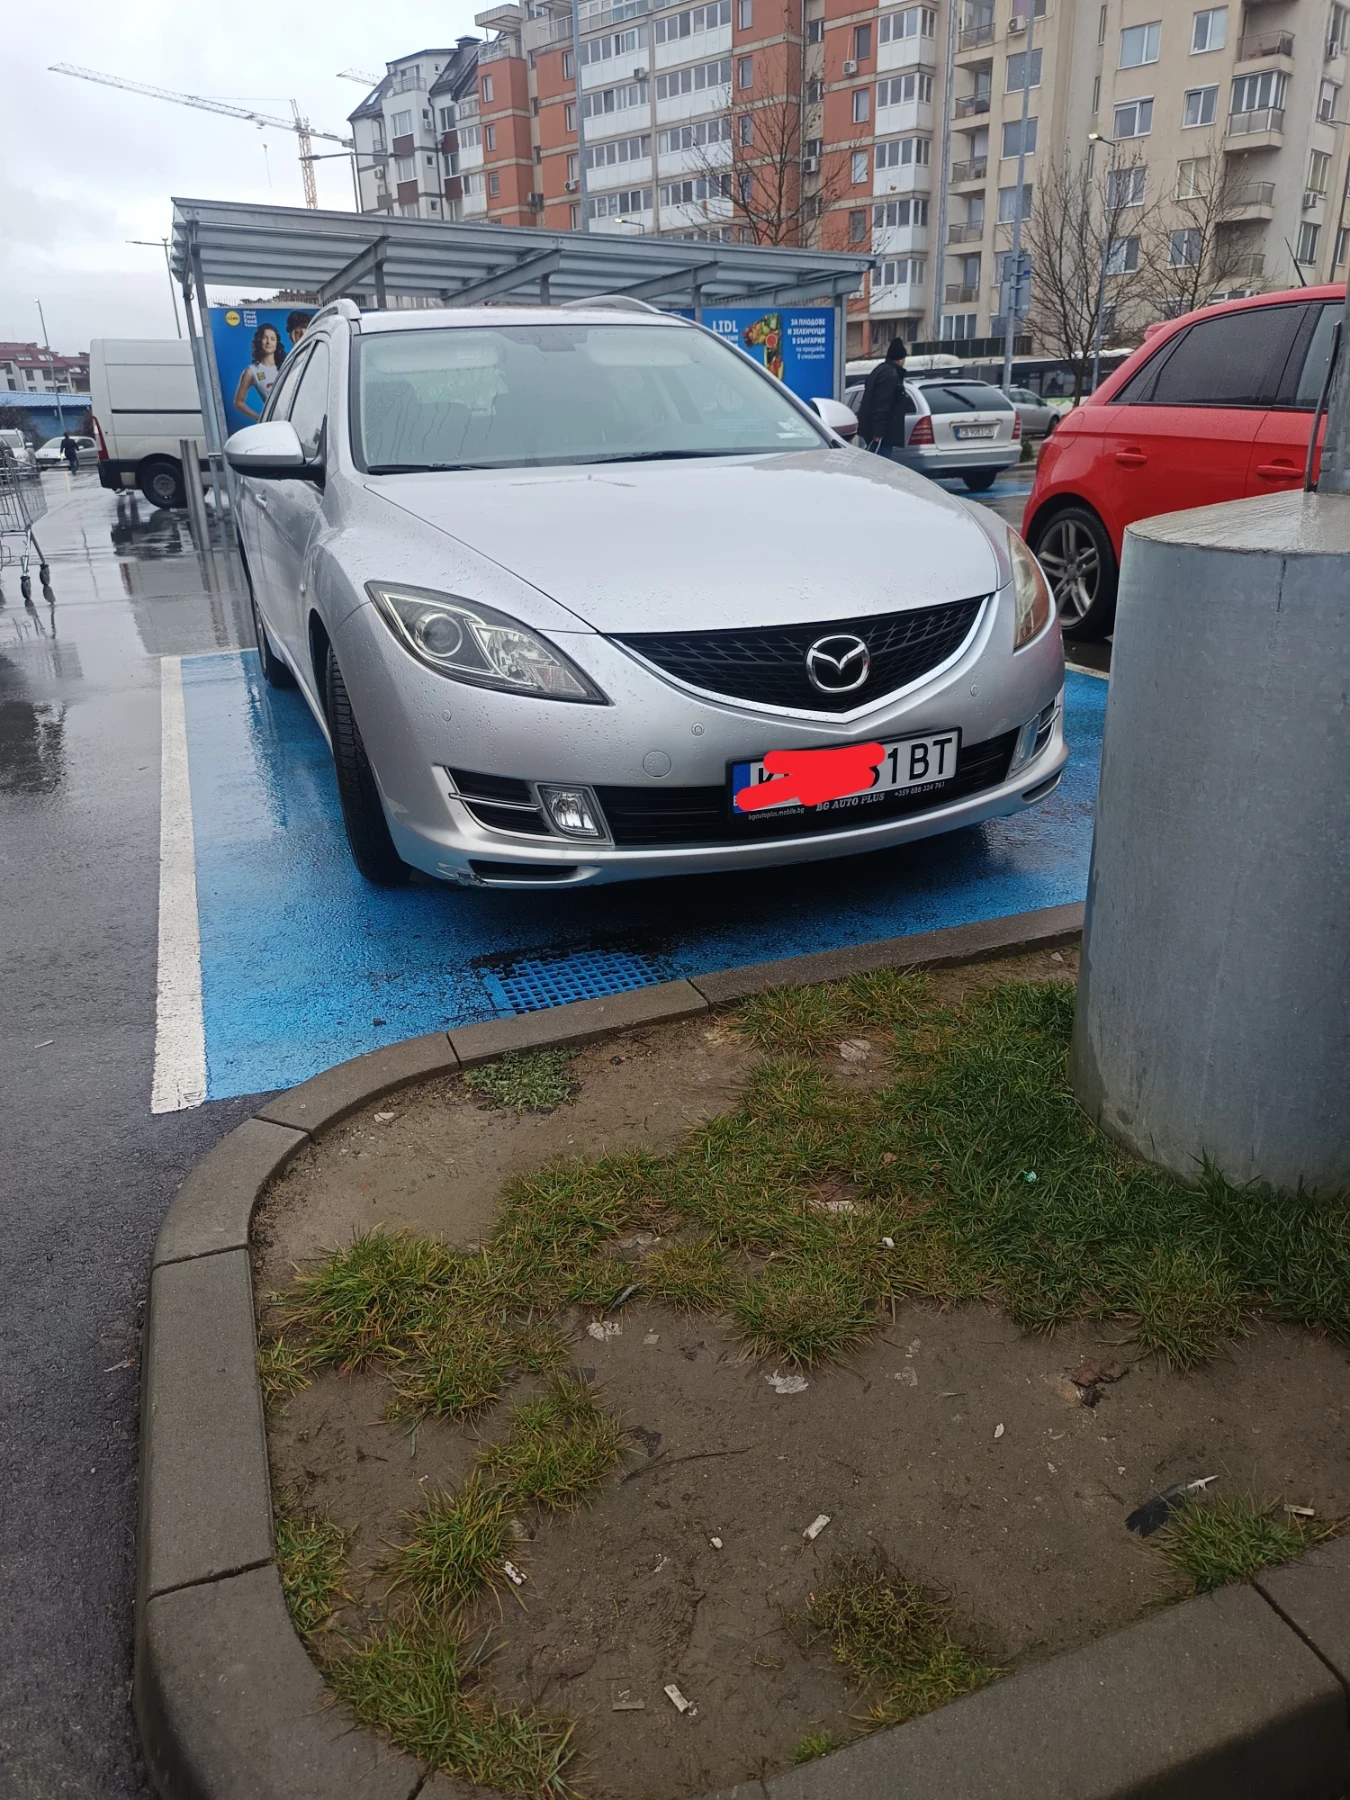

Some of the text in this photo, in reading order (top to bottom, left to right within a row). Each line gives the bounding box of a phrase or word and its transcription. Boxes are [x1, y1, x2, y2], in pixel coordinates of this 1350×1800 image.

[713, 320, 738, 333] LIDL
[799, 318, 825, 326] ПЛОДОВЕ
[793, 327, 825, 335] ЗЕЛЕНЧУЦИ
[797, 336, 825, 344] БЪЛГАРИЯ
[815, 792, 885, 812] BG AUTO PLUS
[748, 806, 805, 821] bgautoplus.mobile.bg
